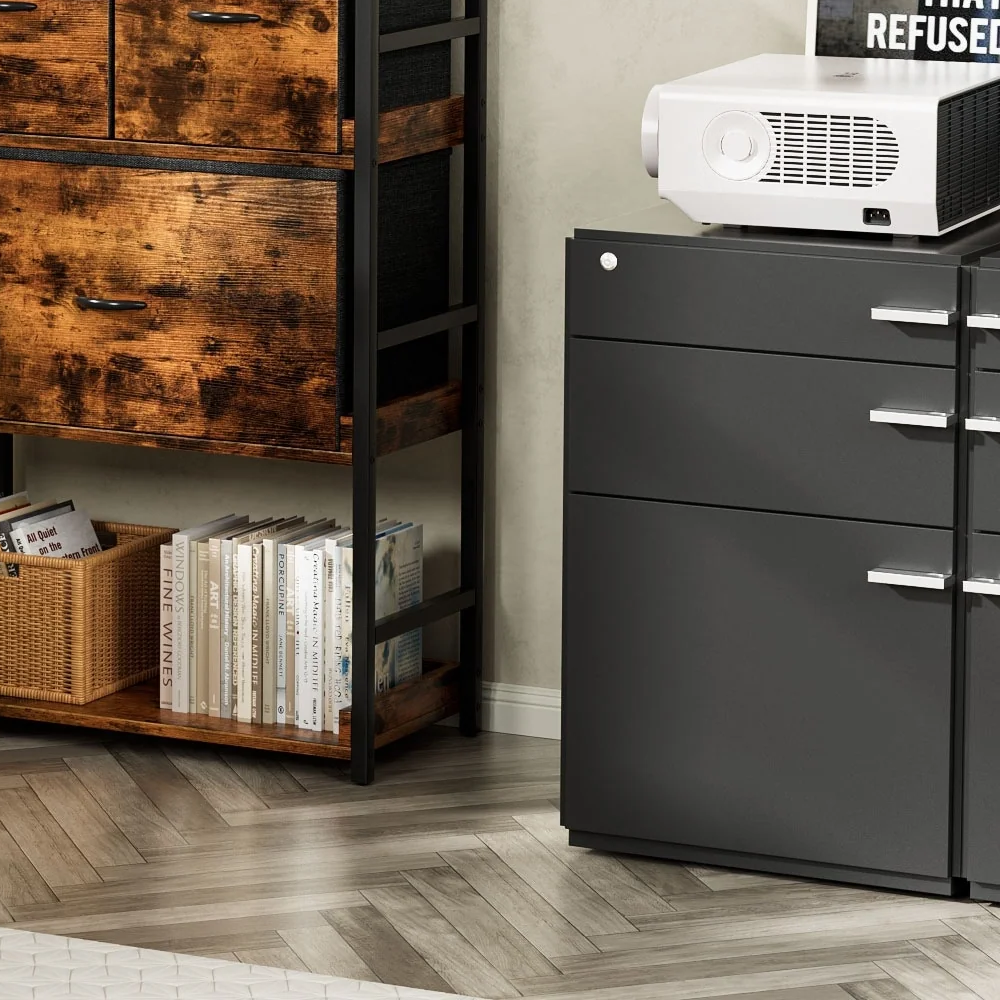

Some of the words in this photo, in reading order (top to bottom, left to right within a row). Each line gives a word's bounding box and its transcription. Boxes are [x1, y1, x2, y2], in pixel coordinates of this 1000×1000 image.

[26, 532, 38, 544] All
[37, 526, 58, 542] Quiet
[38, 545, 48, 556] on
[48, 540, 63, 553] the
[81, 544, 100, 558] Front
[223, 554, 230, 564] An
[175, 541, 185, 613] WINDOWS
[163, 568, 173, 613] FINE
[209, 580, 220, 609] ART
[252, 629, 259, 641] IN
[313, 636, 319, 647] IN
[162, 622, 173, 687] WINES
